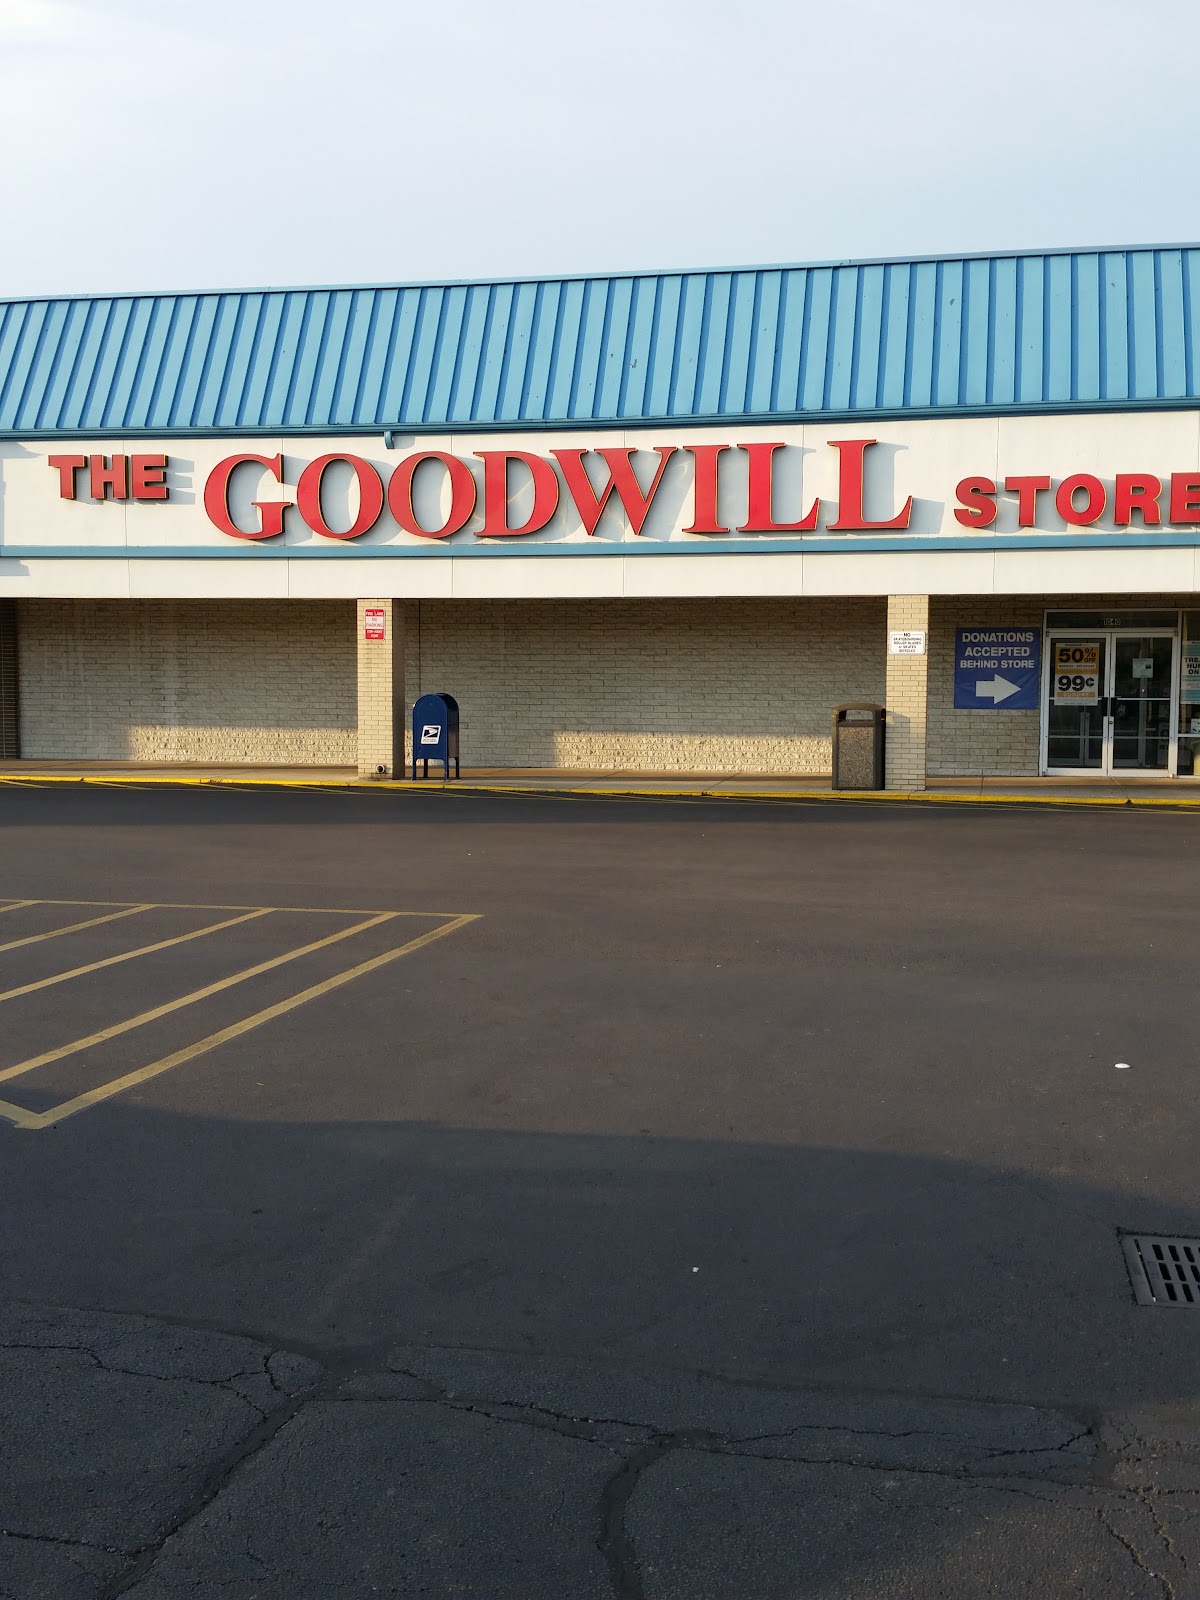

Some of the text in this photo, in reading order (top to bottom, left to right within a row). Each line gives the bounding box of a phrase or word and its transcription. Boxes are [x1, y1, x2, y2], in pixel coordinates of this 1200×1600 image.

[48, 438, 1200, 541] THE GOODWILL STORE
[961, 632, 1034, 642] DONATIONS
[964, 647, 1031, 657] ACCEPTED
[1058, 648, 1096, 663] 50%
[960, 660, 1035, 669] BEHIND STORE
[1058, 675, 1095, 691] 99¢
